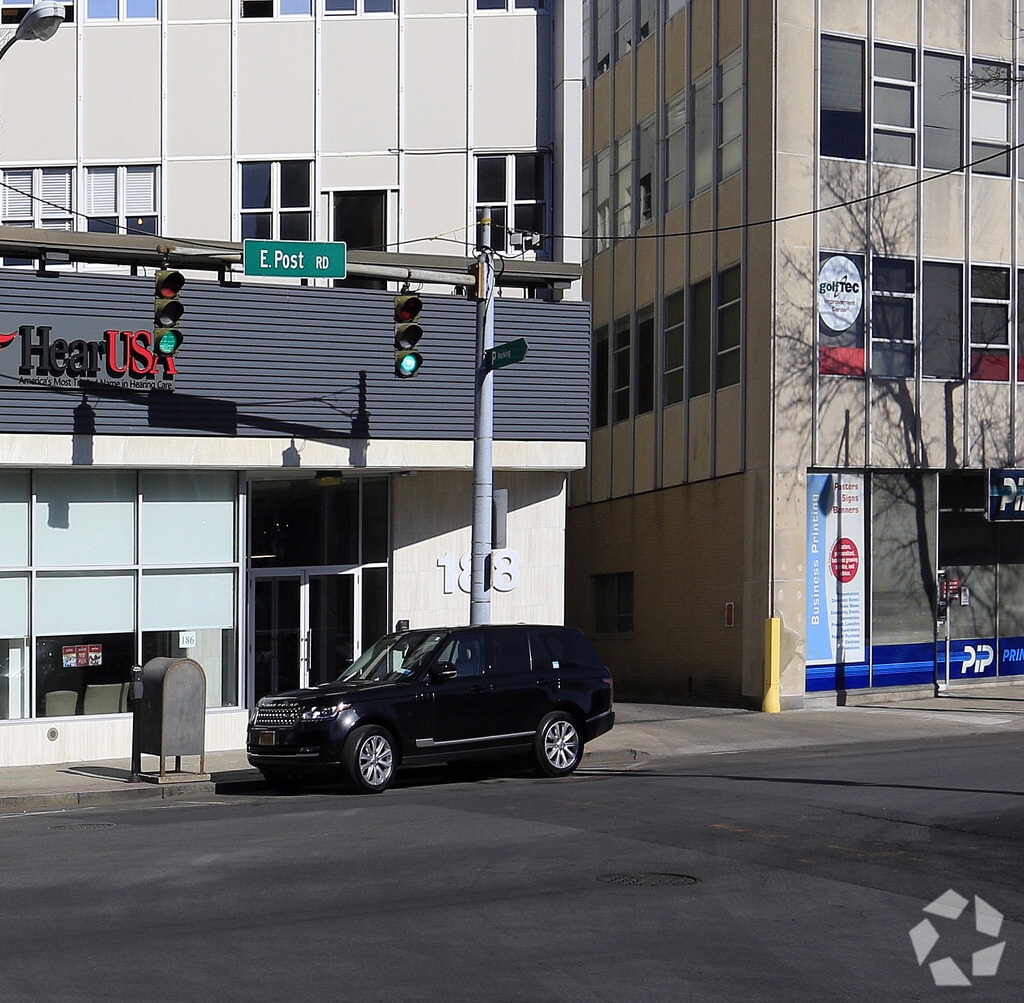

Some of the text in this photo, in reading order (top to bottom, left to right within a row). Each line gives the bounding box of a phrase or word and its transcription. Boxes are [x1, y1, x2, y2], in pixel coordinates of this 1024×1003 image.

[260, 249, 329, 269] E. Post RD
[53, 377, 72, 386] Most
[122, 379, 128, 387] in
[129, 380, 155, 389] Hearing
[833, 482, 859, 491] Posters
[841, 493, 859, 504] Signs
[1000, 477, 1024, 511] PI
[832, 506, 859, 514] Banners
[810, 494, 820, 626] Business Printing
[180, 635, 195, 645] 186
